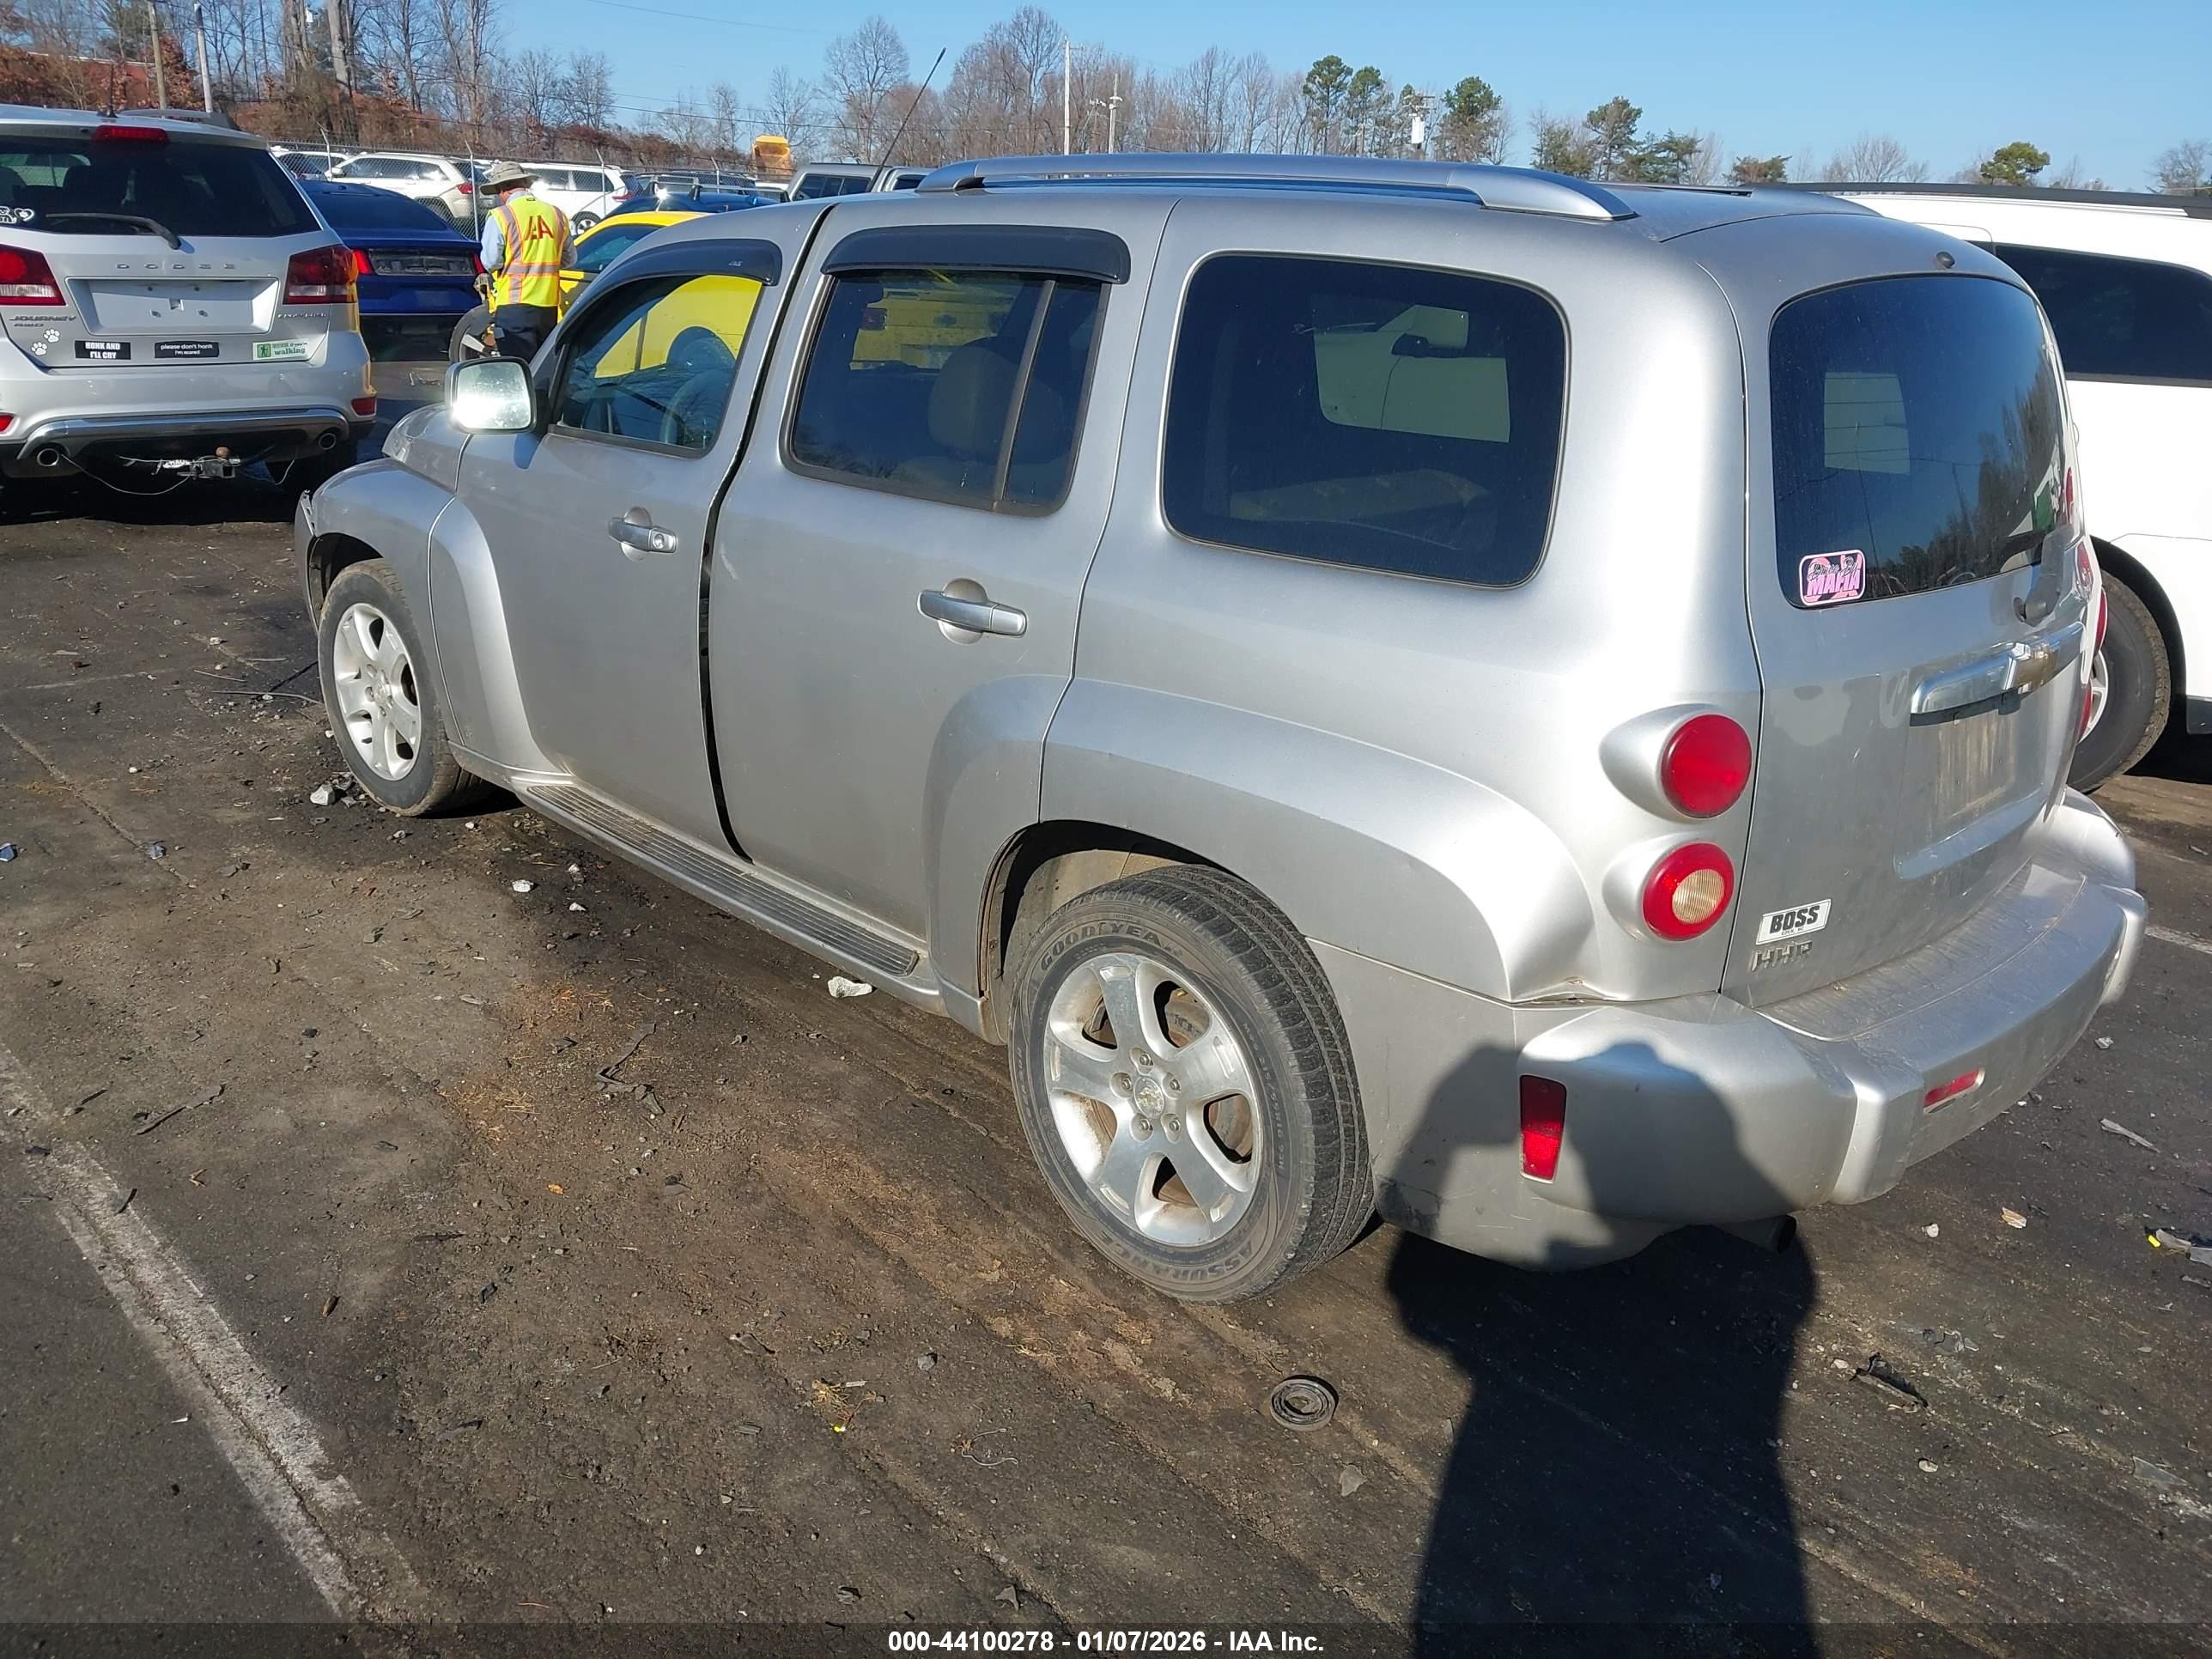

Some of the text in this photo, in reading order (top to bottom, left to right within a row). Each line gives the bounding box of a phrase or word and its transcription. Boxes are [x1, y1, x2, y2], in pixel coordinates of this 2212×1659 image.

[274, 347, 306, 356] walking
[1807, 569, 1861, 597] MAFIA
[1770, 905, 1820, 934] BOSS
